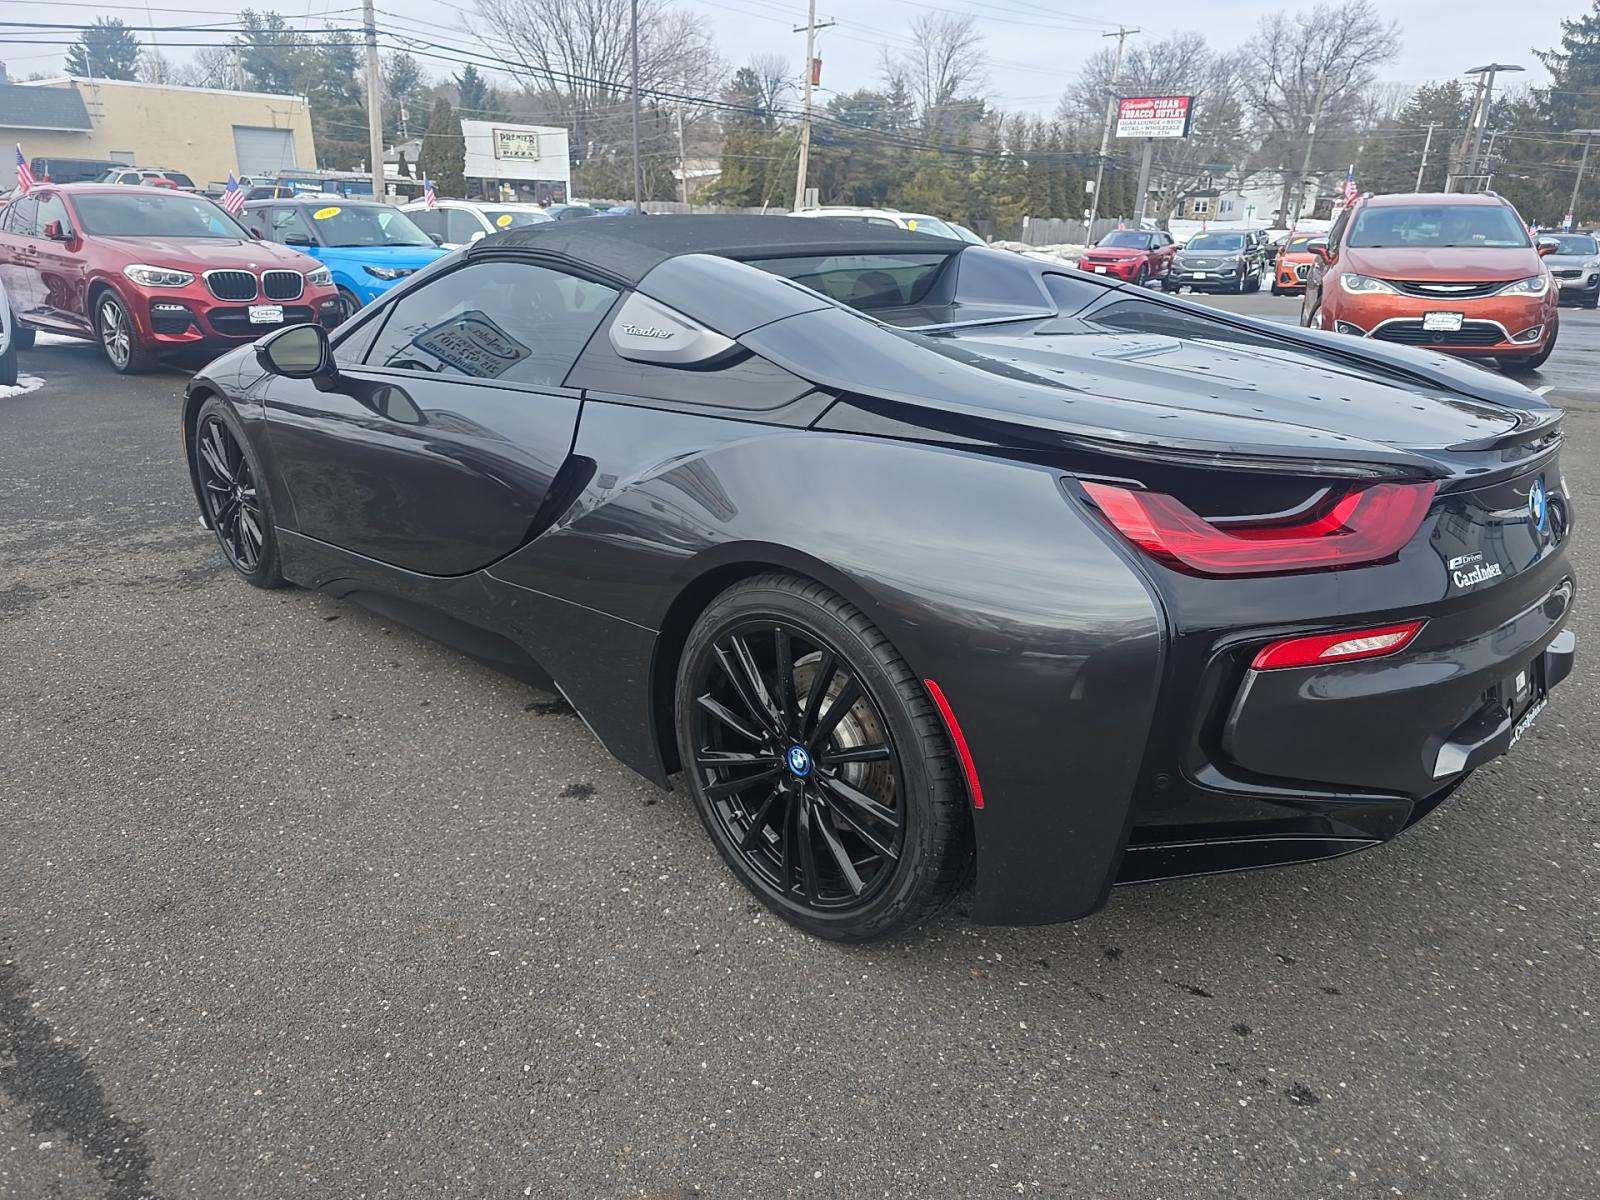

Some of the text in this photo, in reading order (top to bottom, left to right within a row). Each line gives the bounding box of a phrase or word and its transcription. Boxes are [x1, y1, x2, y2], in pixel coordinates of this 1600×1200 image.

[1120, 108, 1187, 119] TOBACCO OUTLET
[500, 133, 535, 144] PREMIER
[621, 324, 674, 339] Roadster
[1453, 562, 1502, 588] CarsIndex
